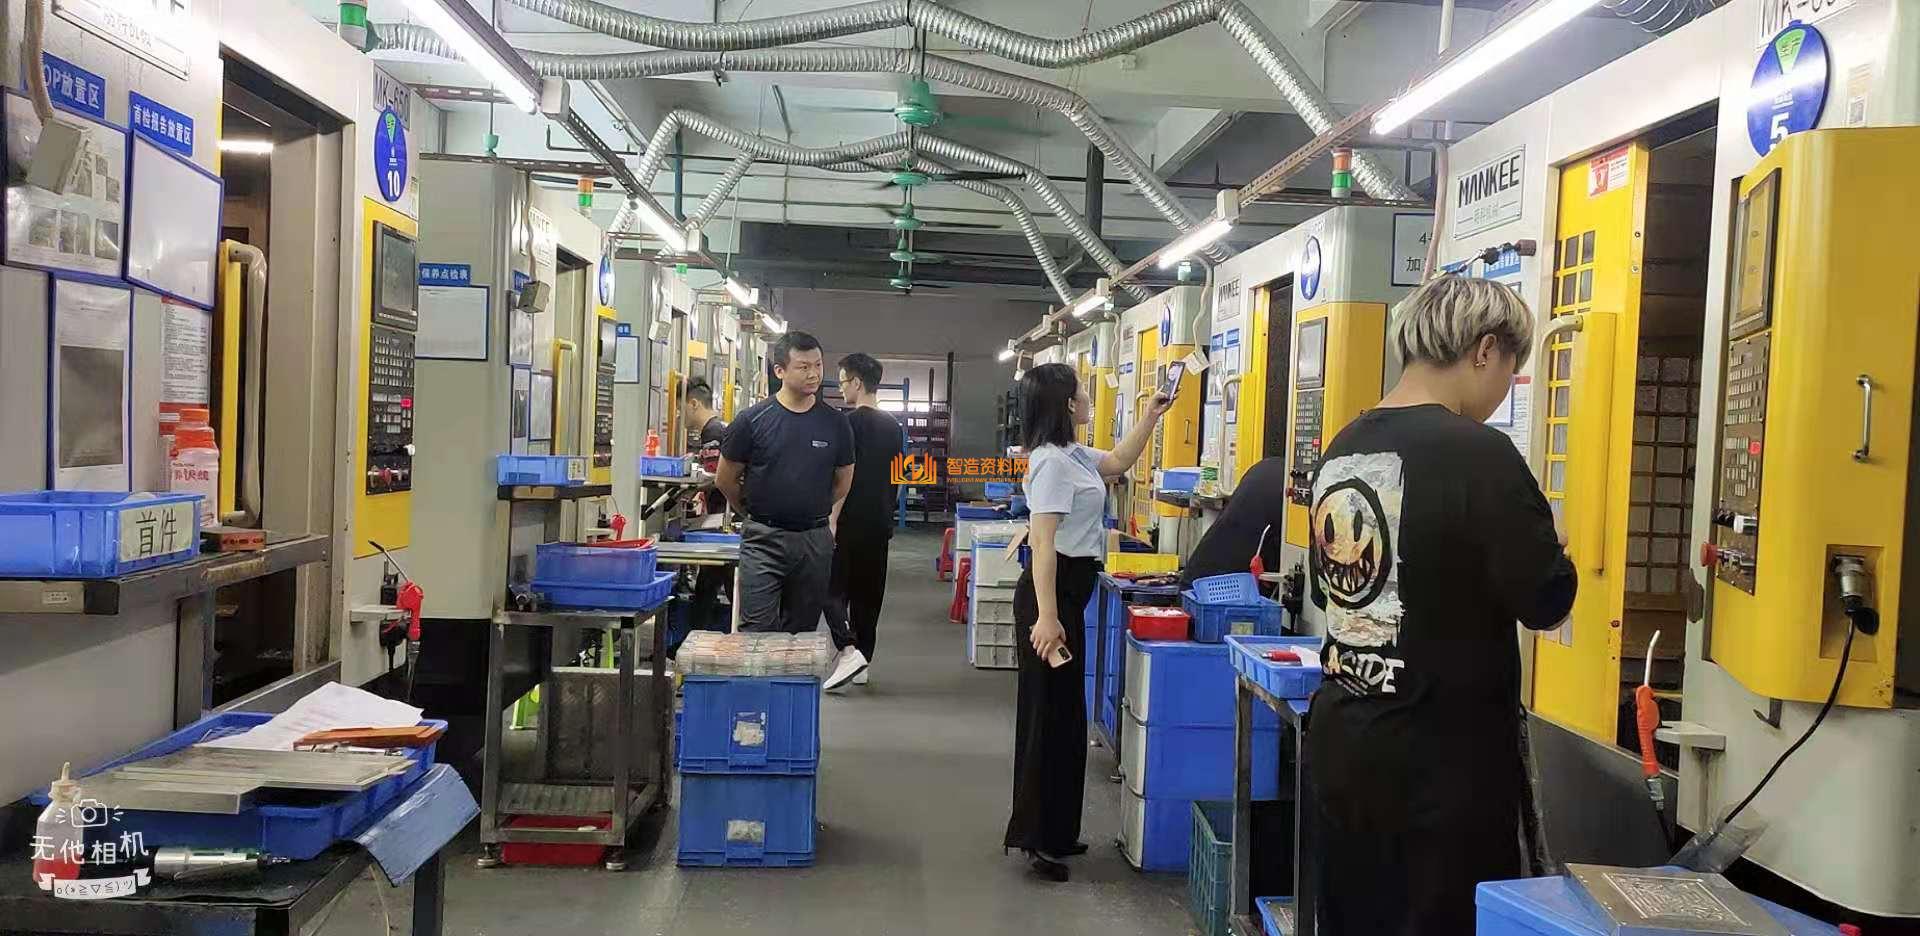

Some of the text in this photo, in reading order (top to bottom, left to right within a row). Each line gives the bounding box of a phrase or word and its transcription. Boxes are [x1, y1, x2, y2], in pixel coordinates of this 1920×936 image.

[132, 104, 193, 145] 首检报告放置区
[1769, 112, 1789, 149] 5
[387, 170, 401, 198] 10
[1458, 154, 1521, 209] MANKEE
[136, 507, 178, 556] 首件
